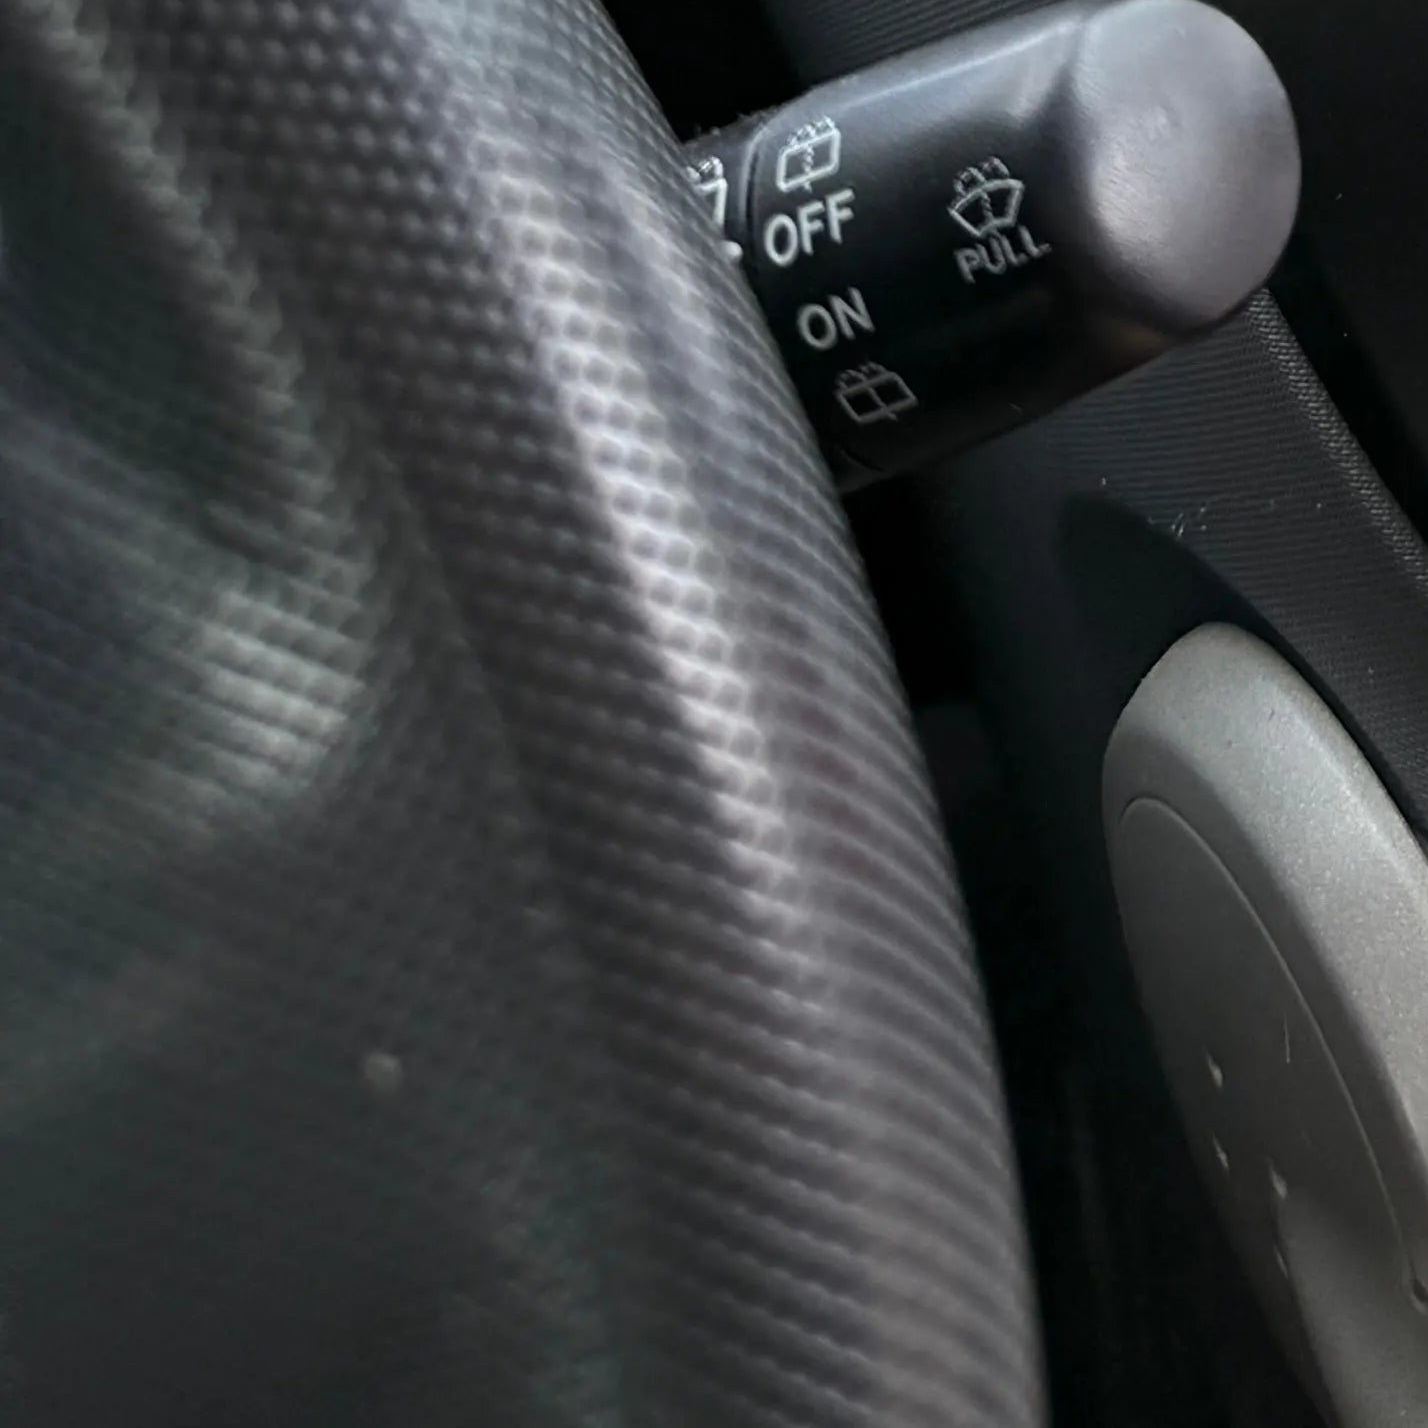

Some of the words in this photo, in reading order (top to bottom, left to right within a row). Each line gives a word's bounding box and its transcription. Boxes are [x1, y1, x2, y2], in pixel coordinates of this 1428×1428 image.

[763, 188, 855, 267] OFF
[953, 225, 1051, 283] PULL
[798, 287, 874, 350] ON
